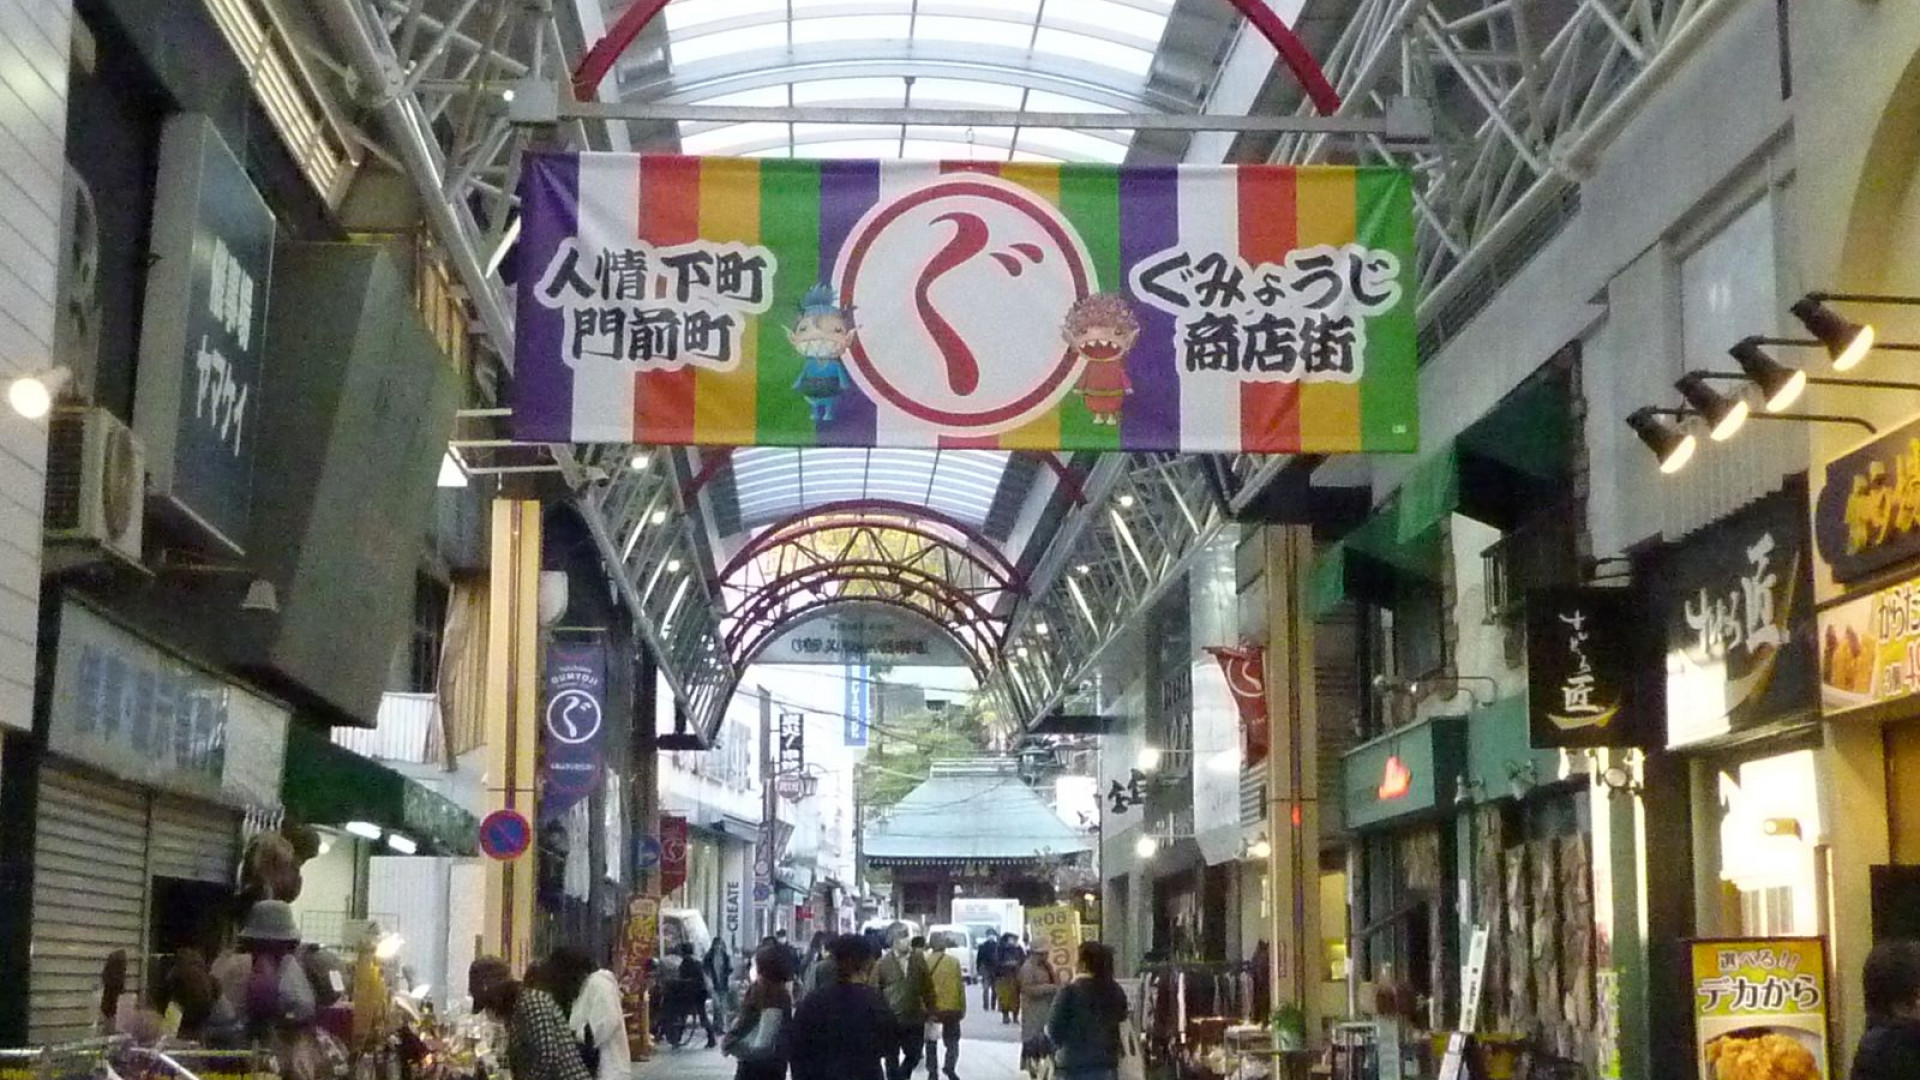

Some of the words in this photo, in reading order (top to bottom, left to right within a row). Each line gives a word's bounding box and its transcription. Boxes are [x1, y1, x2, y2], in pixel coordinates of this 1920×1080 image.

[544, 247, 768, 304] 人情下町
[1138, 251, 1393, 310] ぐみょうじ
[571, 305, 736, 363] 門前町
[1184, 311, 1357, 375] 商店街
[727, 880, 740, 932] CREATE
[1698, 974, 1820, 1012] デカから
